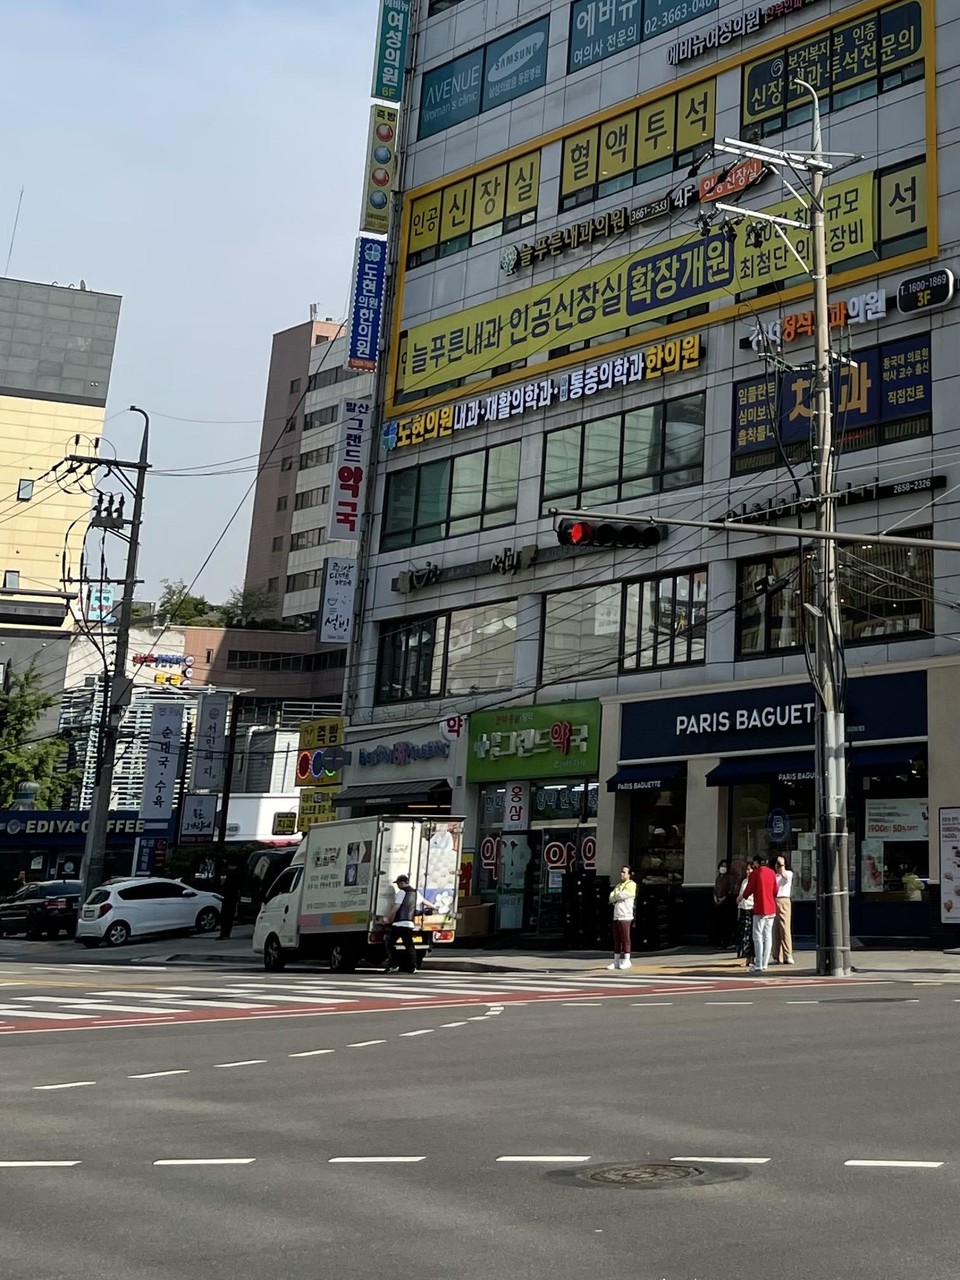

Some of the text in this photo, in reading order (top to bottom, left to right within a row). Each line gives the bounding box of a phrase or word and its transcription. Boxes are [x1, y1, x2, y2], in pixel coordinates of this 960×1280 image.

[383, 12, 404, 87] 여성의원
[494, 43, 539, 71] SAMSUNG
[574, 24, 638, 65] 여의사 전문의
[787, 21, 877, 71] 보건복지부 인증
[382, 87, 396, 98] 6F
[793, 187, 859, 225] 최규모
[889, 176, 917, 224] 석
[519, 206, 627, 268] 늘푸른내과의원
[674, 185, 696, 208] 4F
[740, 218, 864, 280] 최첨단 의장비
[908, 274, 947, 295] 1600-1869
[917, 290, 932, 307] 3F
[412, 239, 731, 375] 늘푸른내과 인공신장실 확장개원
[907, 347, 929, 365] 의료원
[397, 407, 453, 448] 도현의원
[645, 334, 700, 381] 한의원
[887, 385, 925, 406] 직접진료
[676, 702, 816, 736] PARIS BAGUET
[617, 780, 661, 790] PARIS BAGUETTE
[778, 772, 796, 782] PARIS
[26, 820, 145, 834] EDIYA CFFEE
